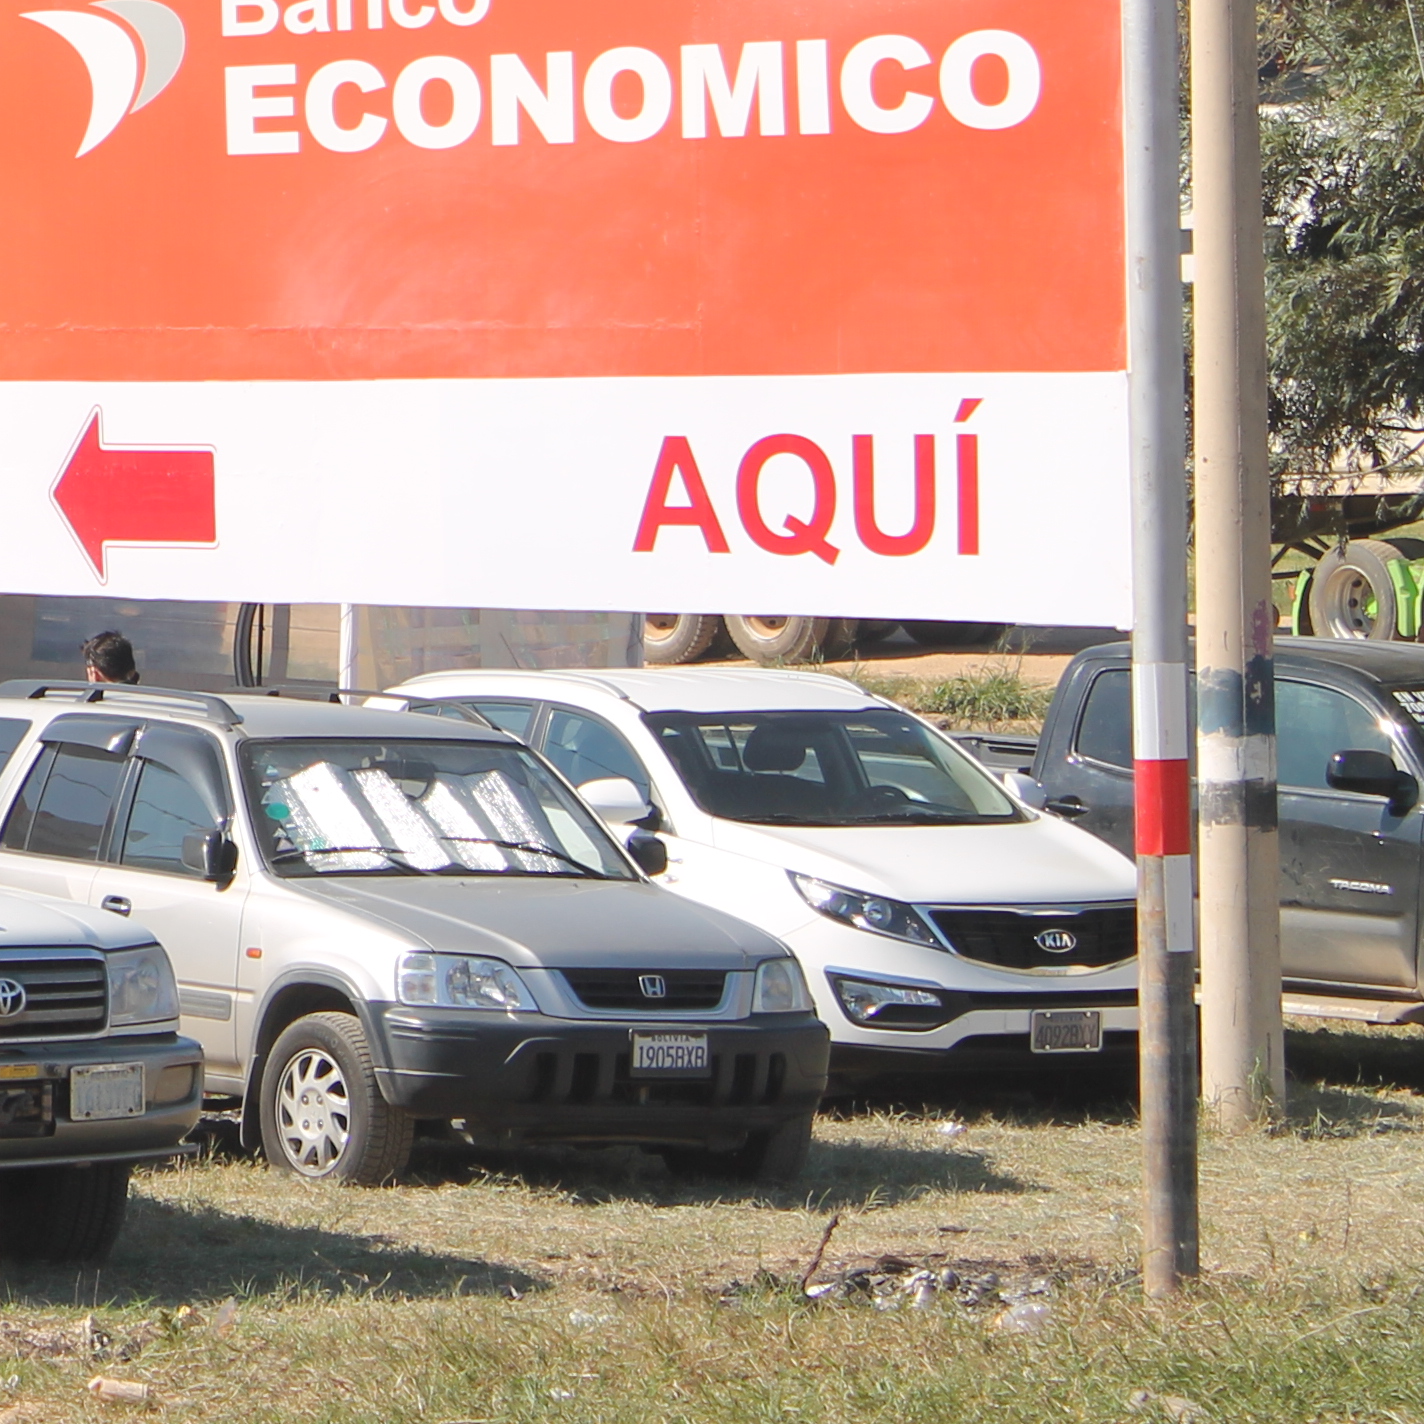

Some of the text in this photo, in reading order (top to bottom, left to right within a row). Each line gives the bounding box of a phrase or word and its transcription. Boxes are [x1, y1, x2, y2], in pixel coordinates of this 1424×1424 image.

[222, 28, 1042, 156] ECONOMICO
[631, 396, 985, 567] AQUÍ
[1044, 932, 1072, 948] KIA
